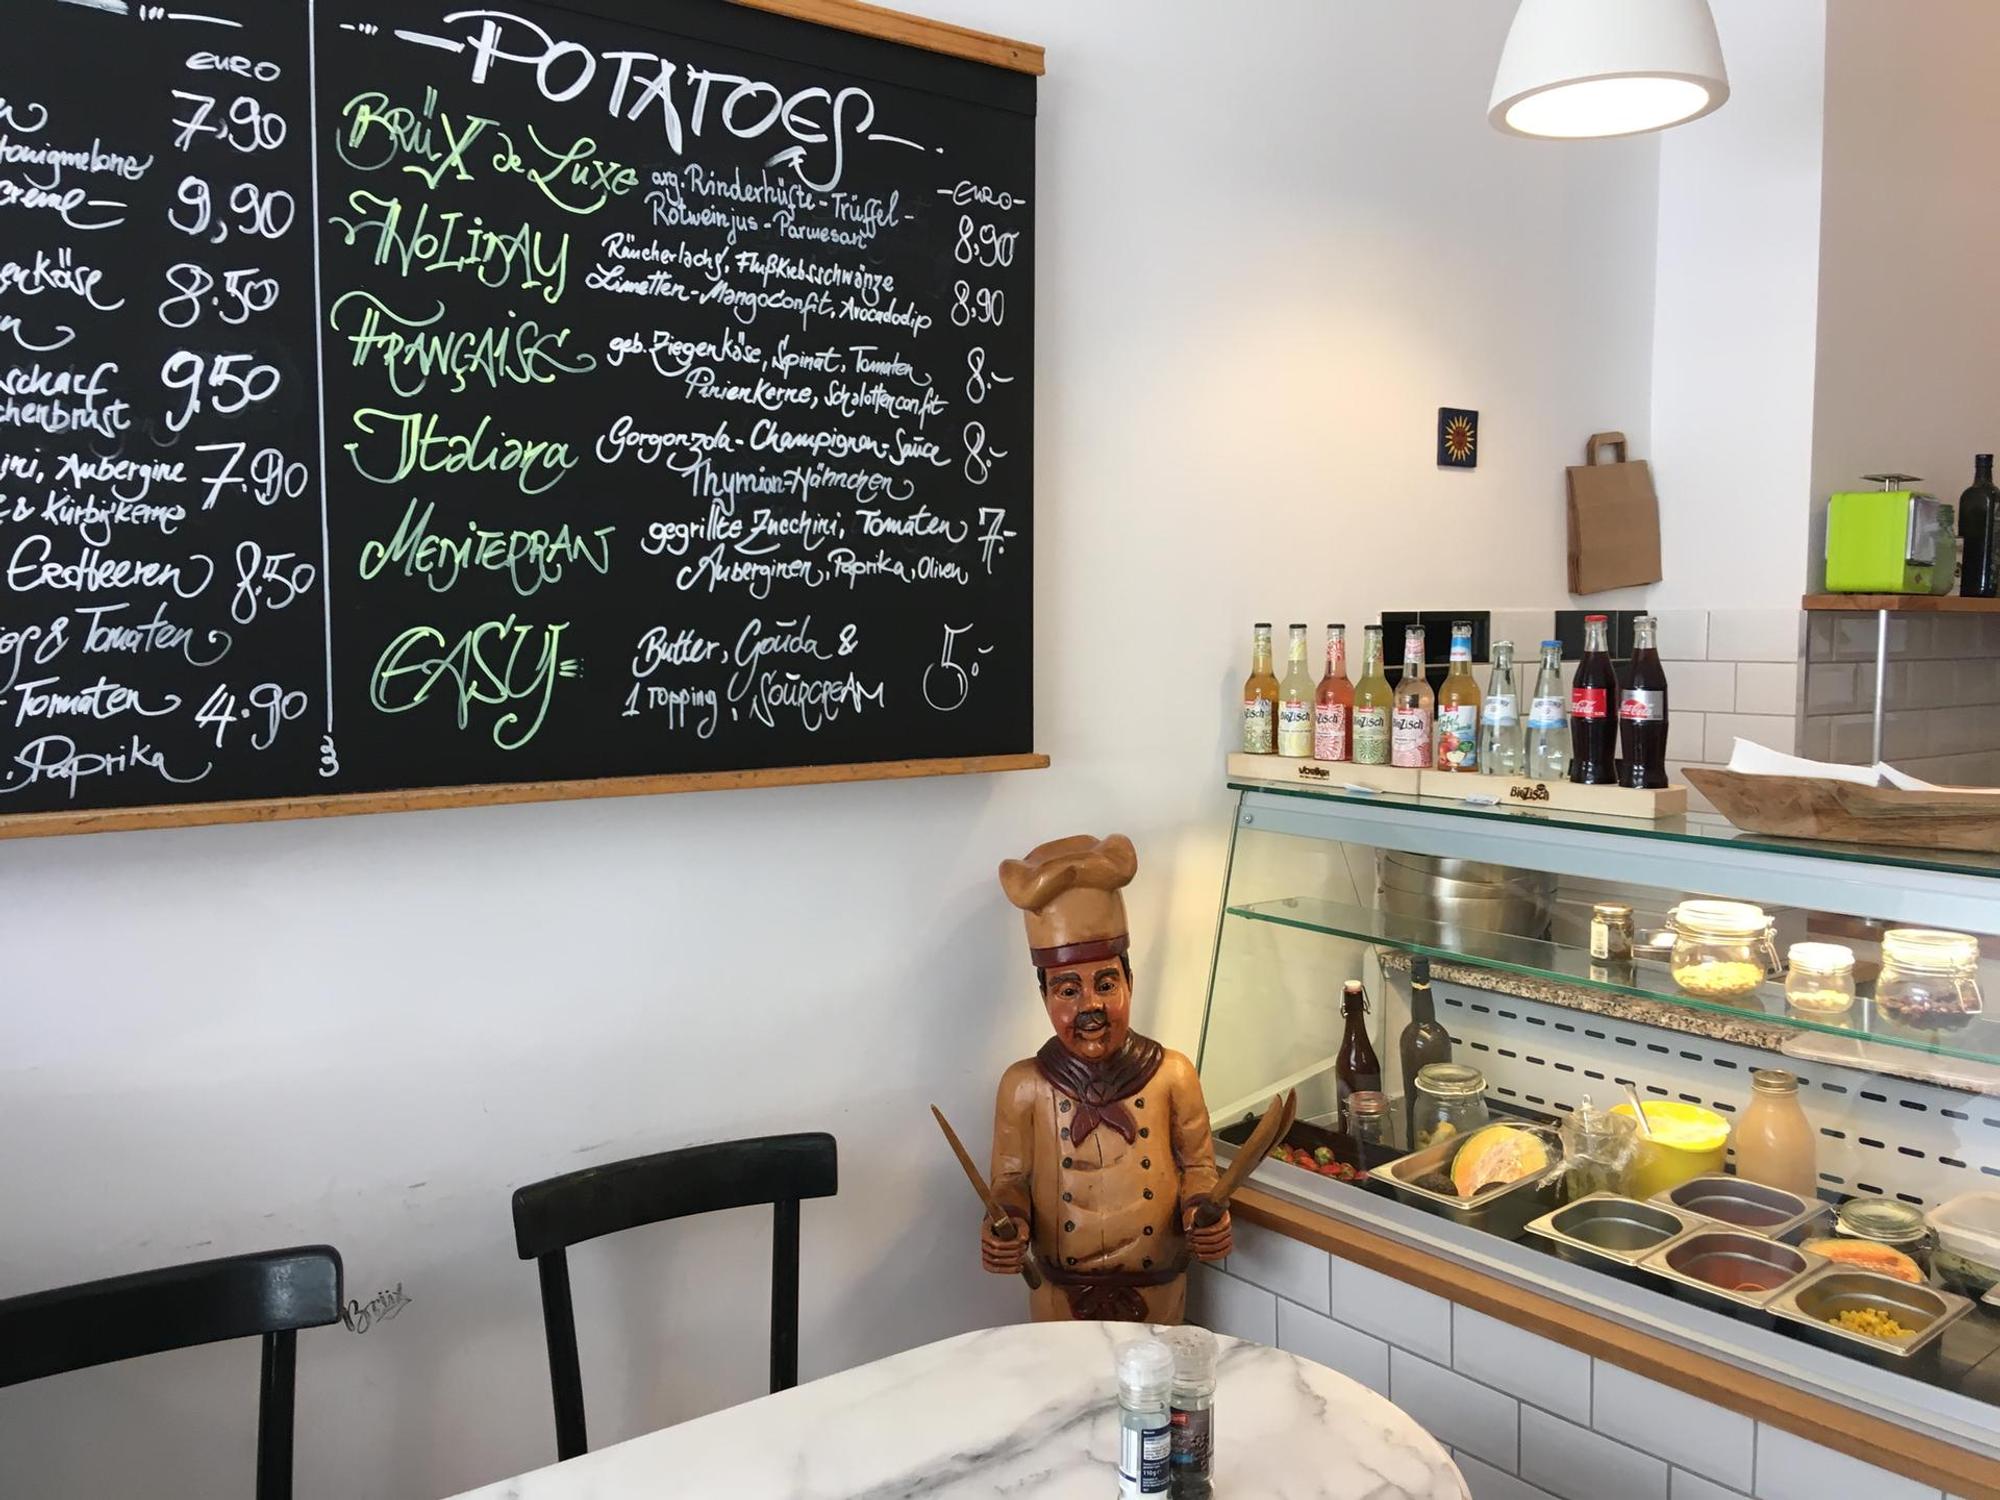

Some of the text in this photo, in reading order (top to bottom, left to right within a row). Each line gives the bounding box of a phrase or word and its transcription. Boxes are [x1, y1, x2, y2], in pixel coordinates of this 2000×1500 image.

[443, 9, 874, 191] POTATOES
[167, 176, 295, 244] 9,90
[0, 247, 125, 311] enkäse
[855, 503, 969, 544] Tomaten
[74, 601, 233, 667] Tomaten
[837, 622, 859, 656] &
[14, 675, 182, 728] Tomaten
[621, 682, 641, 718] 1
